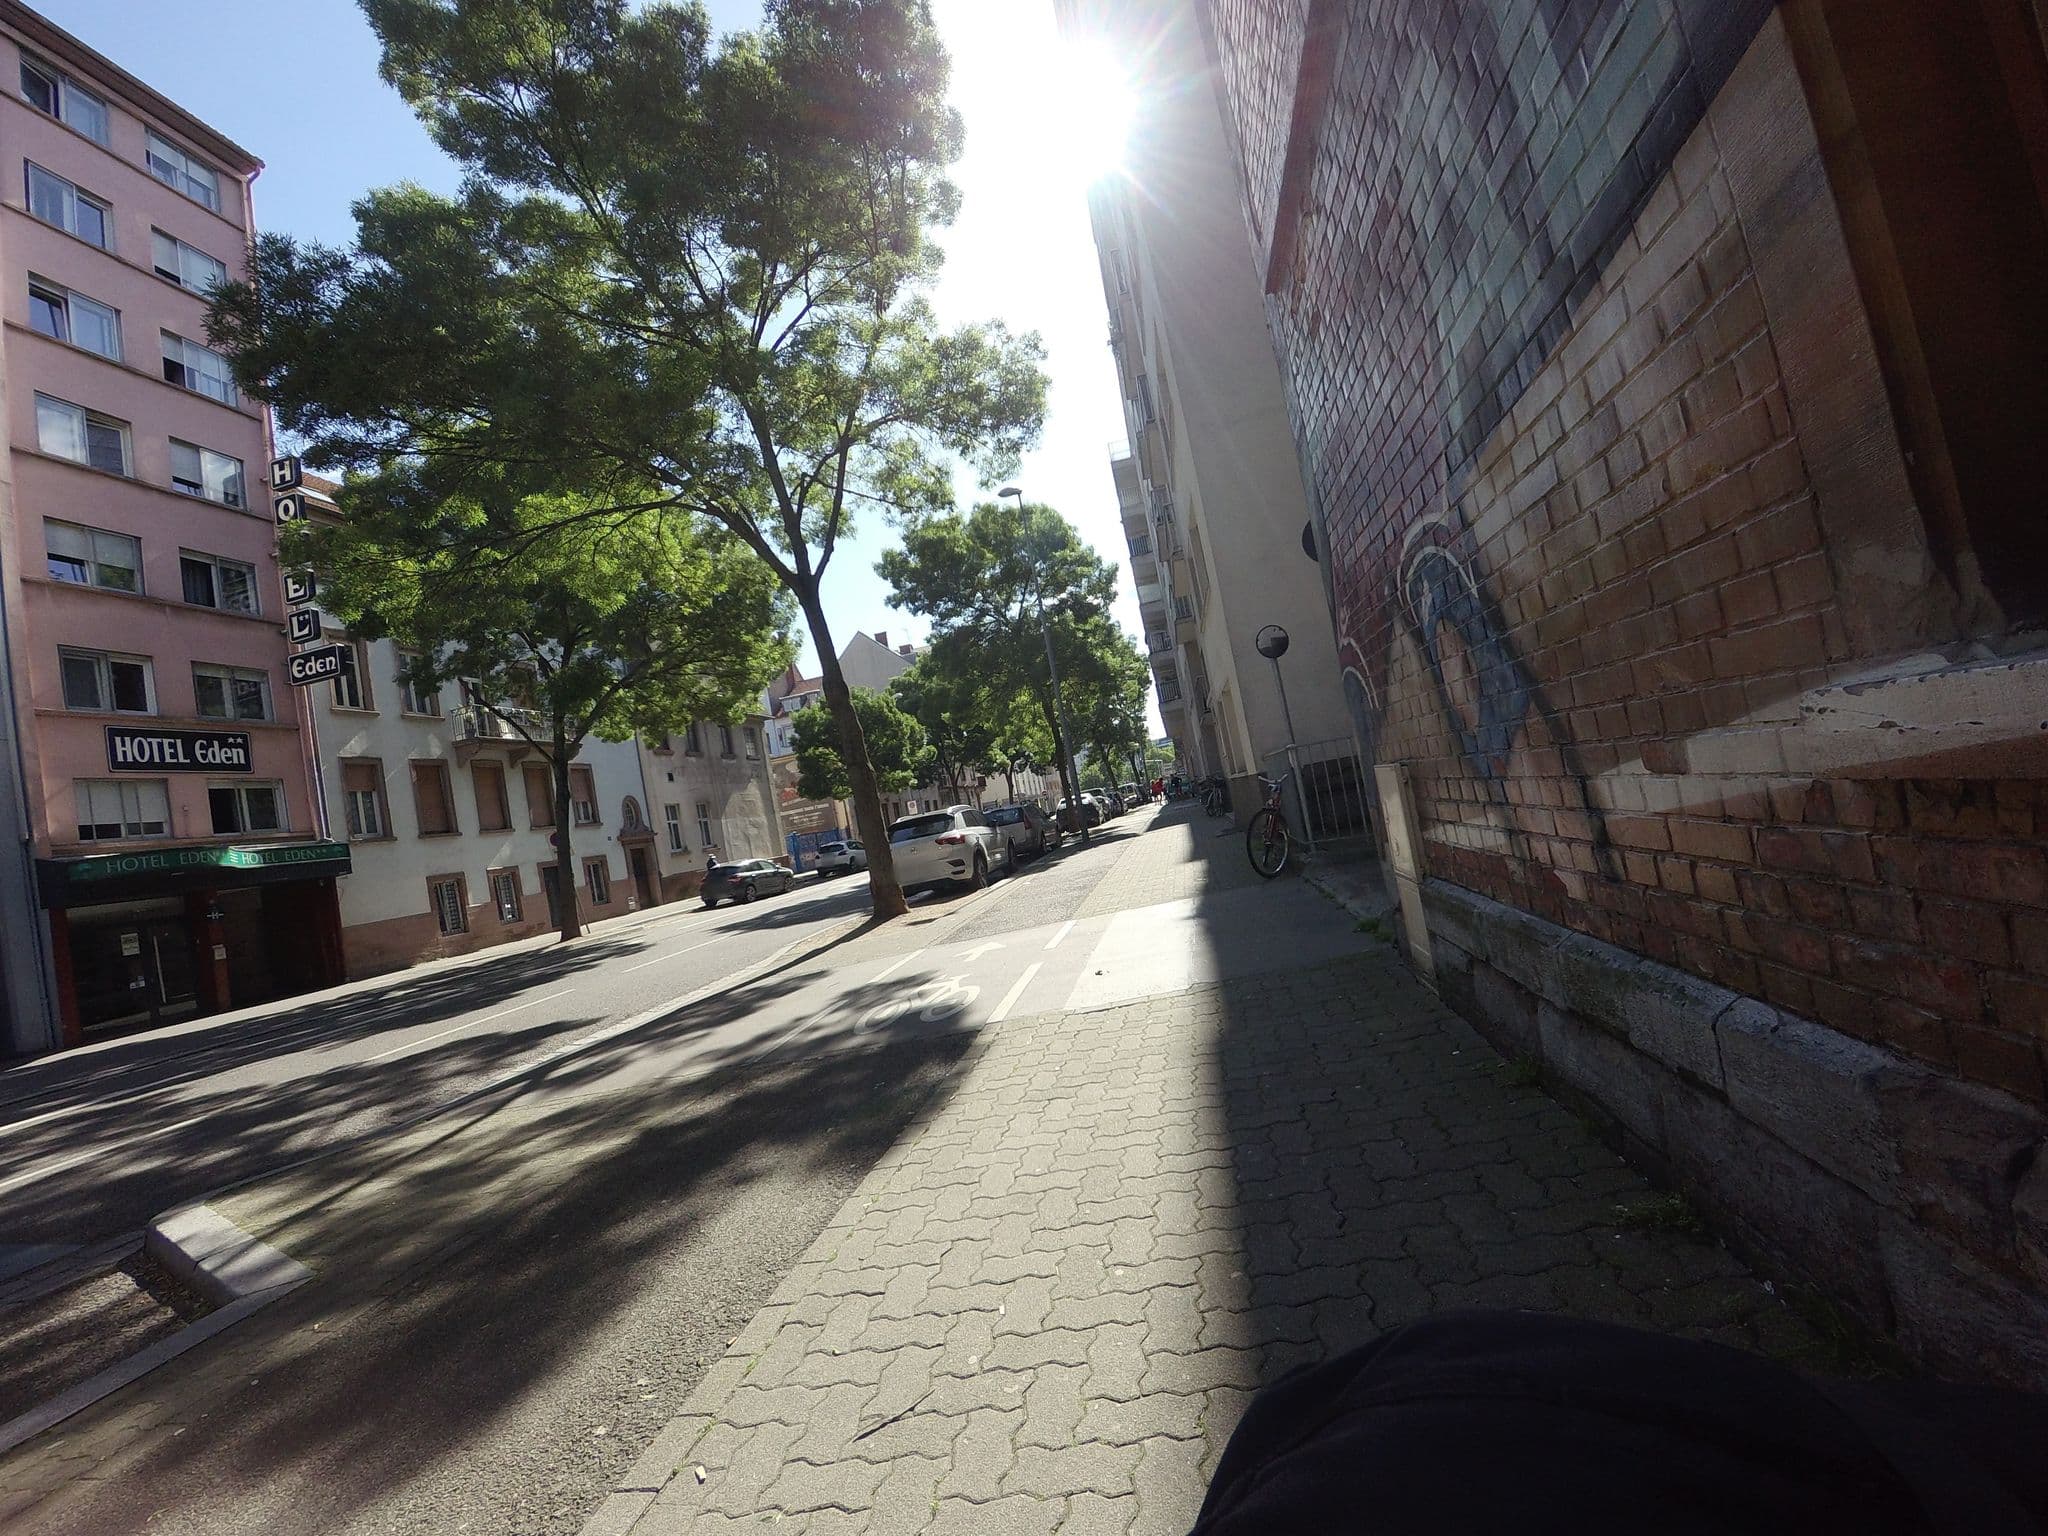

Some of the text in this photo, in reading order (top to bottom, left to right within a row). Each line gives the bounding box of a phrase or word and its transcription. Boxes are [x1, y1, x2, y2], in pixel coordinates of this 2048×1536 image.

[273, 461, 310, 637] HOEL
[292, 655, 336, 678] Eden
[115, 736, 246, 765] HOTEL Eden
[106, 851, 218, 874] HOTEL EDEN
[242, 849, 315, 865] HOTEL EDEN
